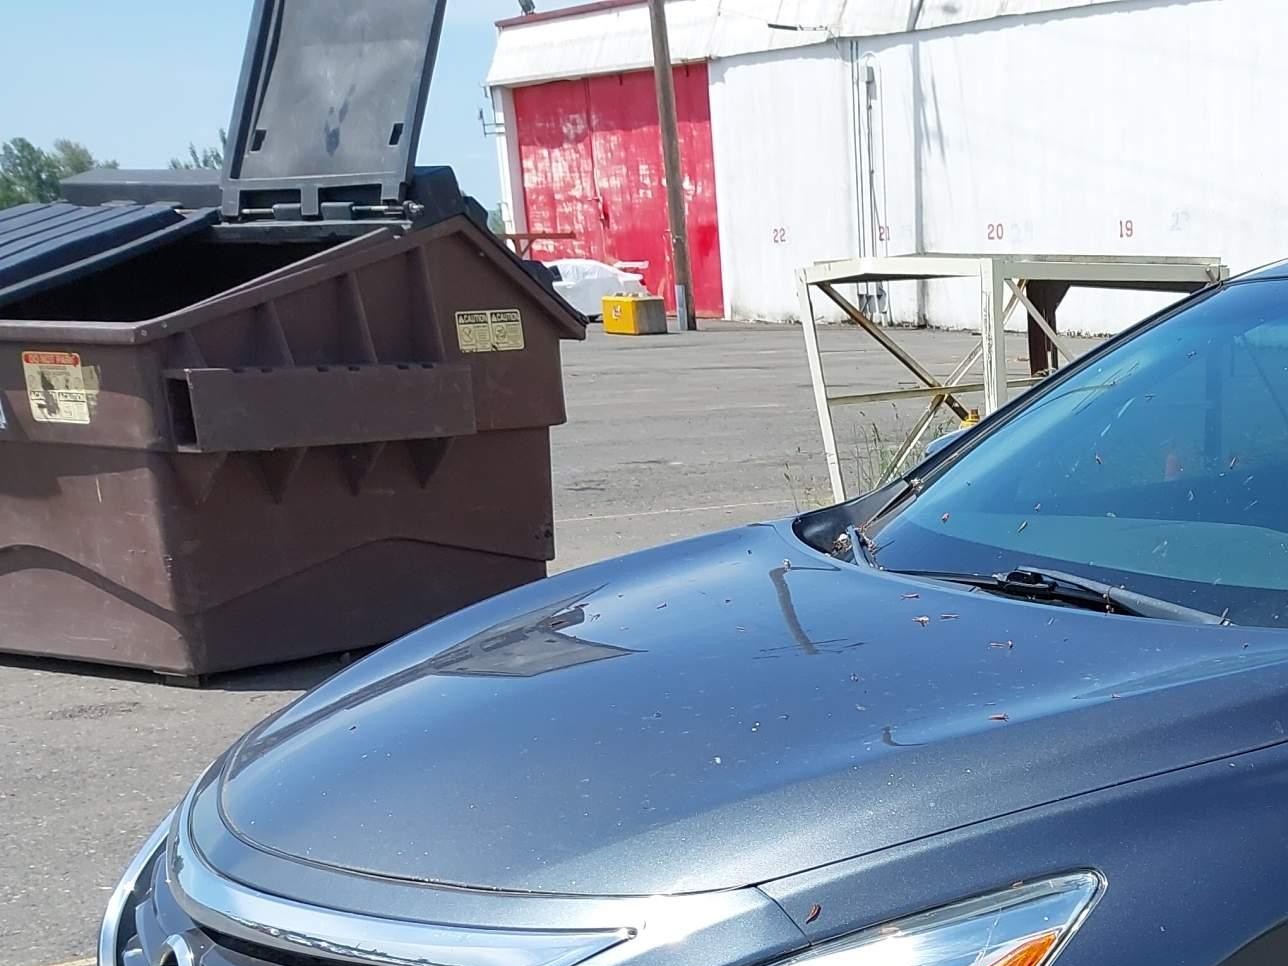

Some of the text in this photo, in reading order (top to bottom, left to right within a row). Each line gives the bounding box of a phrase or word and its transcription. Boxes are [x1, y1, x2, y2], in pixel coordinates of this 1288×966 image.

[773, 227, 786, 243] 22
[879, 225, 890, 241] 21
[987, 223, 1004, 240] 20
[1119, 220, 1133, 239] 19
